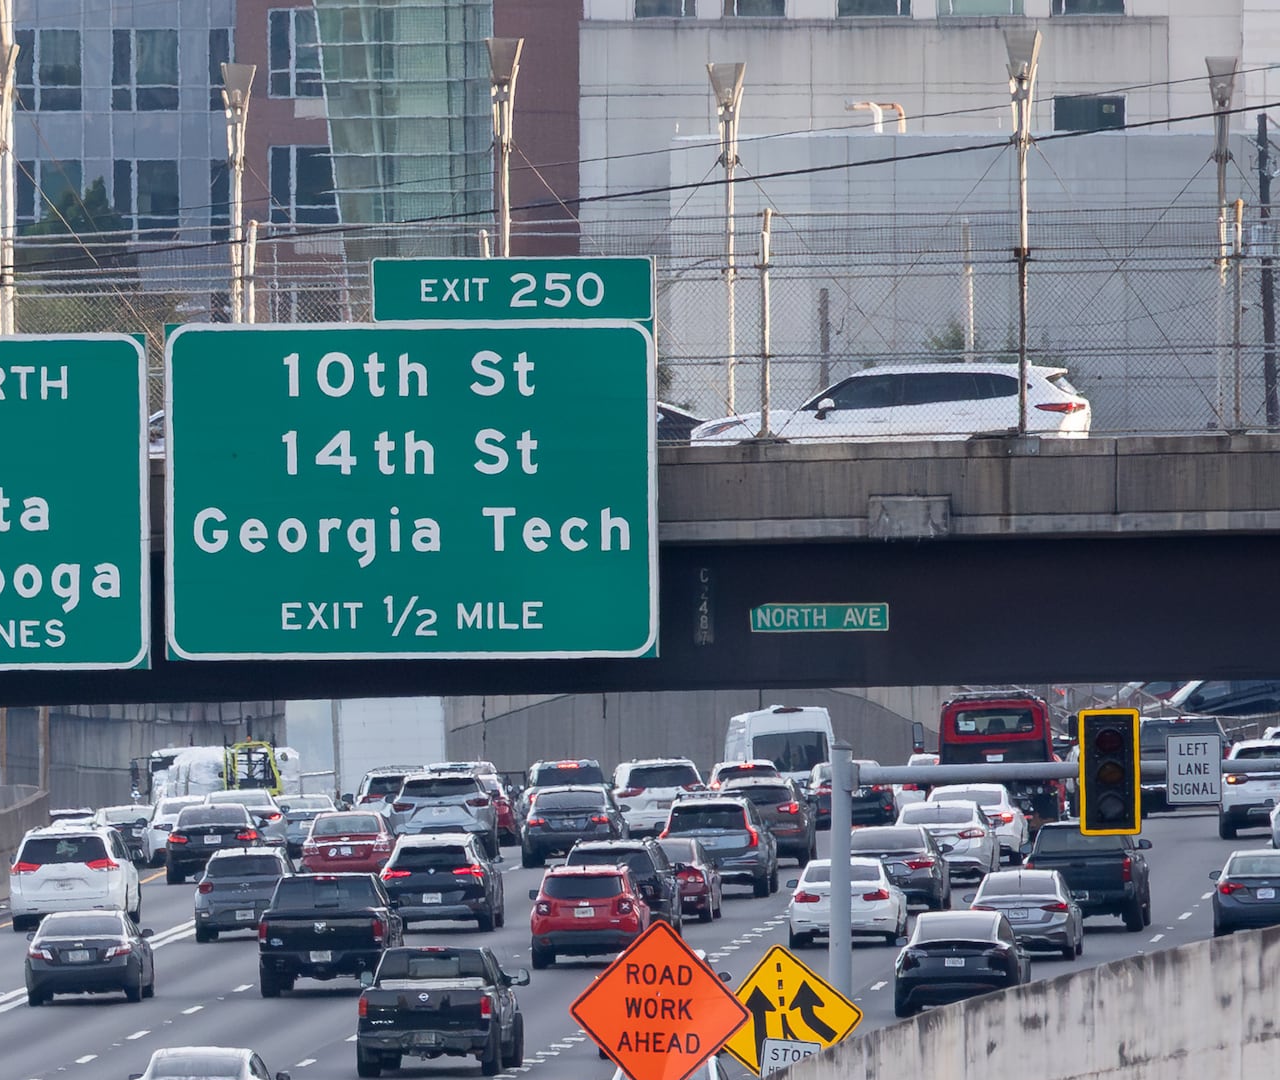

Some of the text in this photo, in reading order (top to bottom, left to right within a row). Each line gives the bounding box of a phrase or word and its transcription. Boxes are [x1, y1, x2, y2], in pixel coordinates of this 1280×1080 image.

[421, 272, 604, 307] EXIT 250
[284, 351, 534, 397] 10th St
[282, 429, 537, 475] 14th St
[194, 507, 630, 567] Georgia Tech
[282, 603, 362, 629] EXIT
[458, 602, 543, 629] MILE
[757, 607, 882, 627] NORTH AVE
[1179, 743, 1208, 756] LEFT
[1178, 763, 1210, 775] LANE
[1172, 782, 1217, 795] SIGNAL
[626, 963, 693, 986] ROAD
[625, 997, 693, 1020] WORK
[617, 1031, 700, 1054] AHEAD
